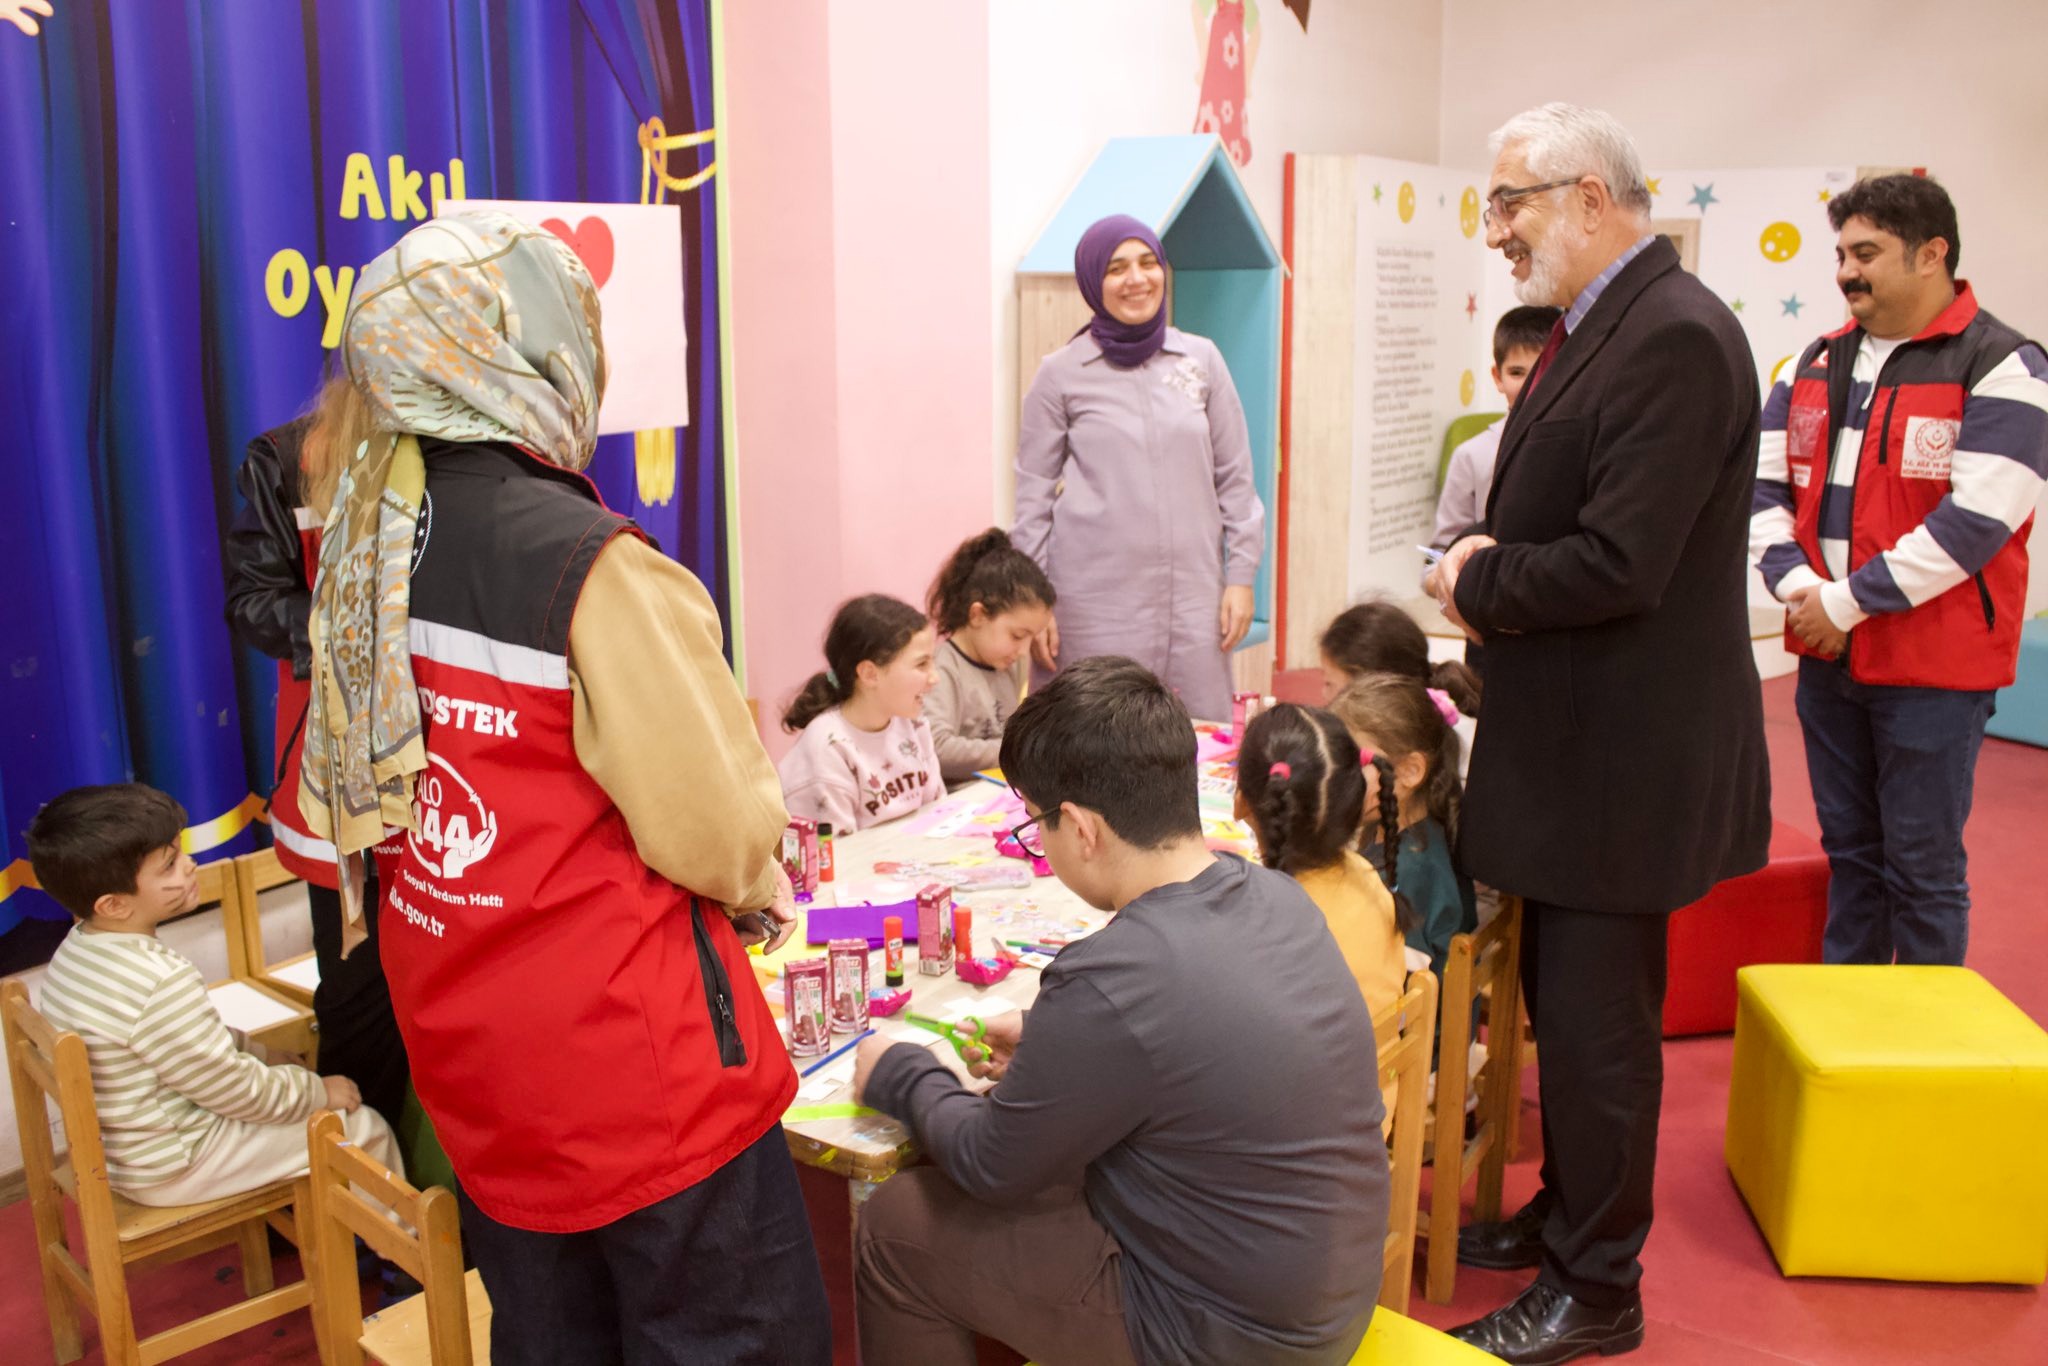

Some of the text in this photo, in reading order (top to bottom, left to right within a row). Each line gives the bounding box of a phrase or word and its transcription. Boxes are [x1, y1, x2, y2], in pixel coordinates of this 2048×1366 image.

[339, 153, 466, 221] Akıl
[265, 248, 369, 349] Oy
[418, 686, 518, 738] DSTEK
[417, 773, 442, 808] ALO
[412, 800, 474, 857] 144
[403, 869, 504, 908] Sosyal Yardım Hattı
